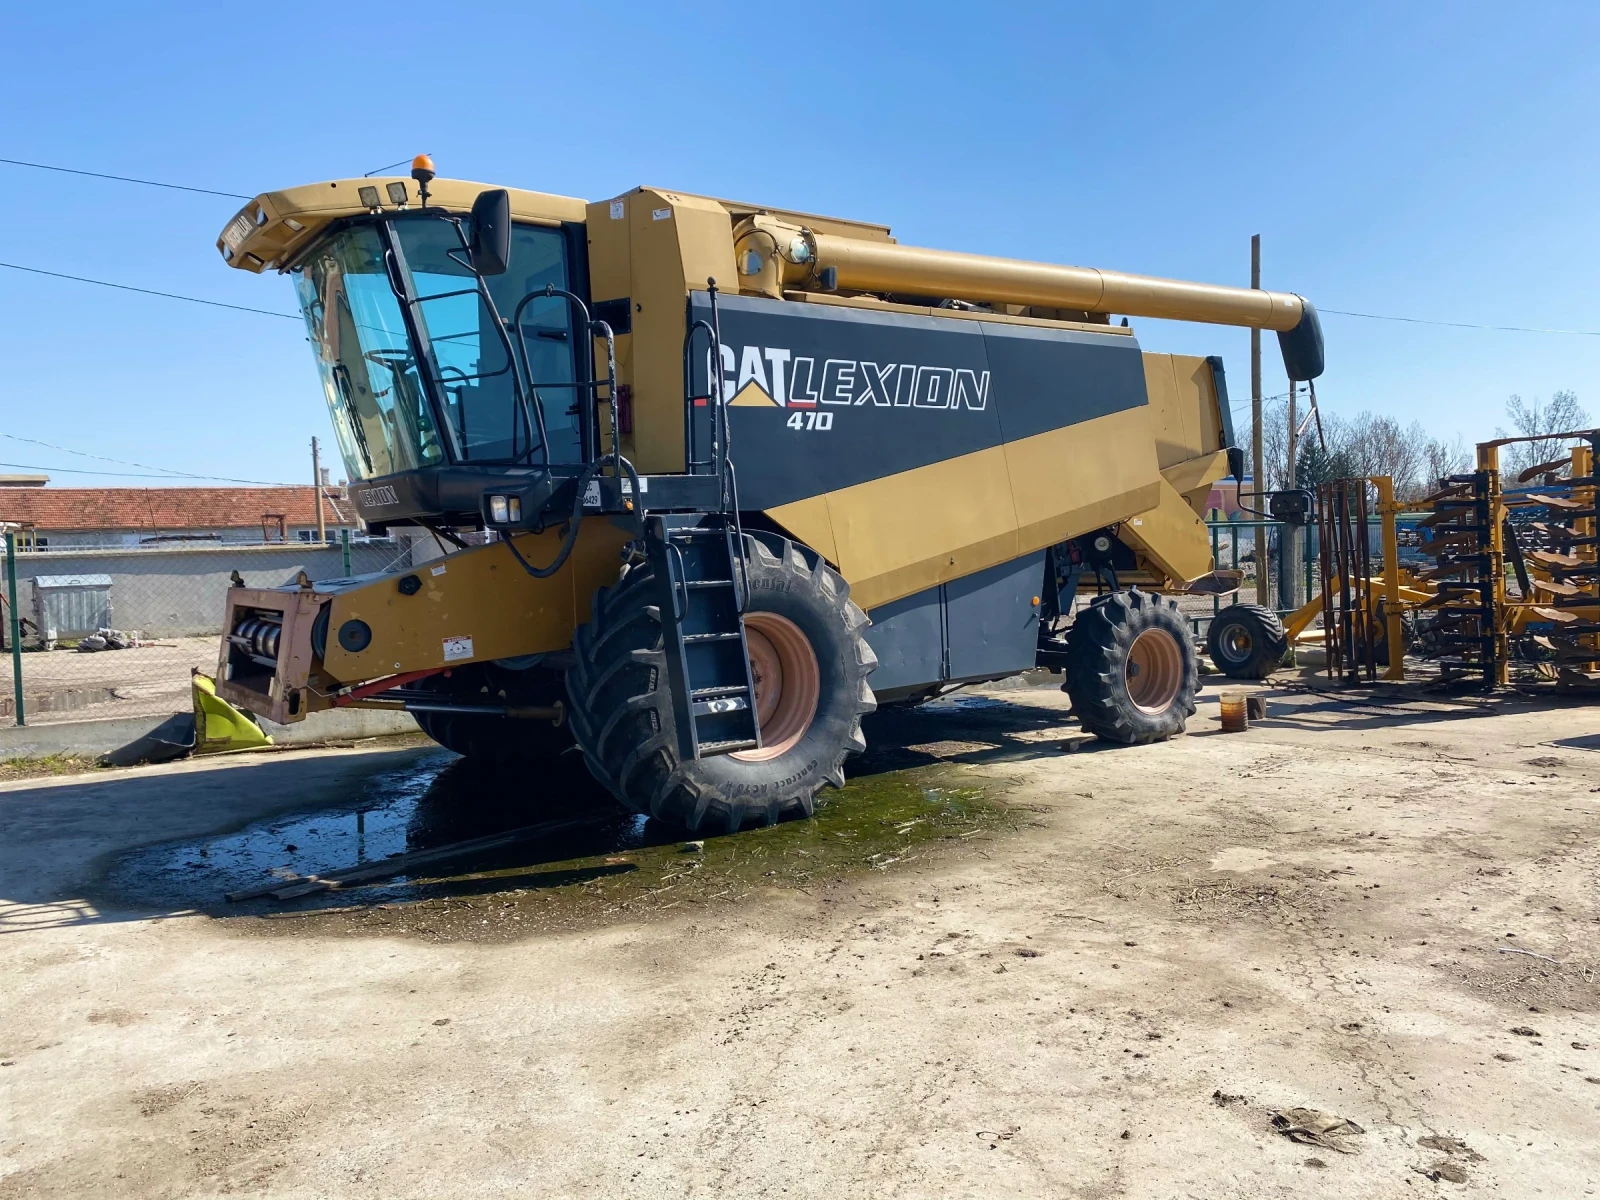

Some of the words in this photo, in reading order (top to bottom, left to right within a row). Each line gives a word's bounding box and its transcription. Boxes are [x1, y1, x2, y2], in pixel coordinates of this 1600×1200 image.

[707, 343, 790, 407] CAT
[789, 356, 990, 410] LEXION
[787, 411, 833, 430] 470
